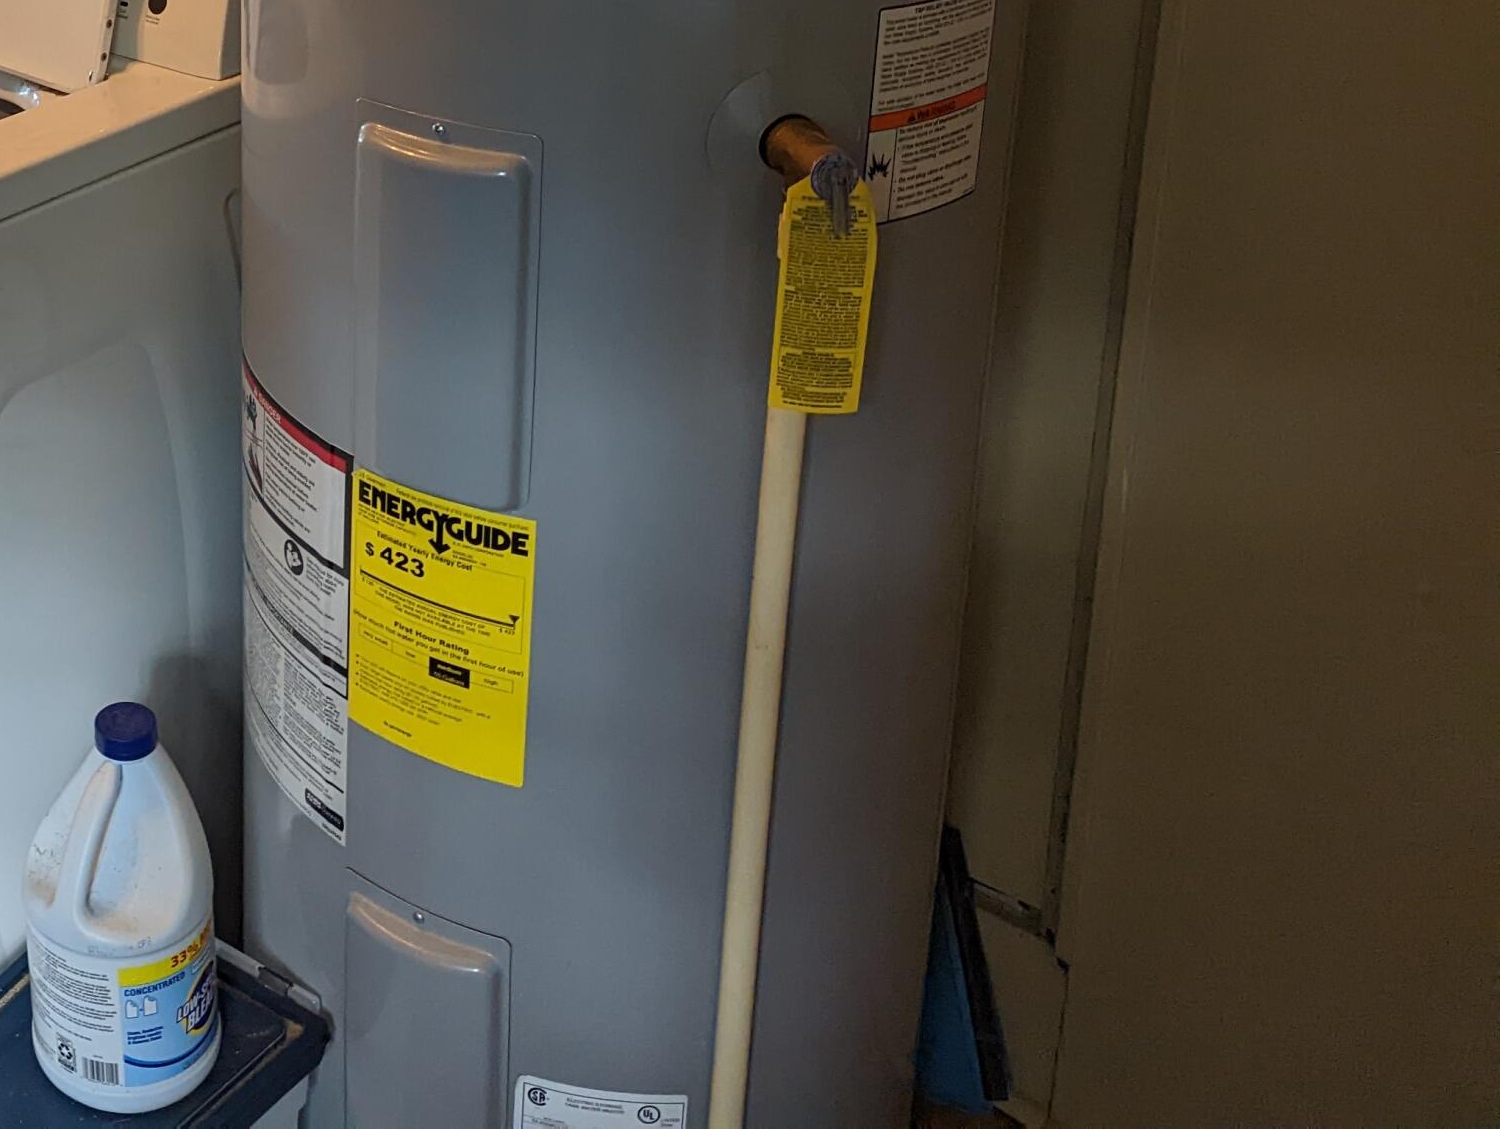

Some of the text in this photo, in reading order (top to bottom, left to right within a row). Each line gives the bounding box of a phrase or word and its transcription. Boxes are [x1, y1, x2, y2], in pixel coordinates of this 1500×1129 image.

[358, 479, 530, 557] ENERGYGUIDE
[365, 542, 425, 578] $ 423
[377, 531, 408, 550] Estimated
[408, 543, 430, 559] Yearly
[430, 552, 456, 568] Energy
[456, 561, 473, 572] Cost
[394, 621, 470, 656] First Hour Rating
[397, 632, 415, 643] water
[415, 641, 428, 650] you
[429, 645, 440, 654] get
[449, 651, 461, 661] the
[462, 656, 478, 665] first
[479, 661, 497, 671] hour
[171, 941, 199, 968] 33%
[124, 971, 186, 997] CONCENTRATED
[643, 1108, 655, 1121] UL
